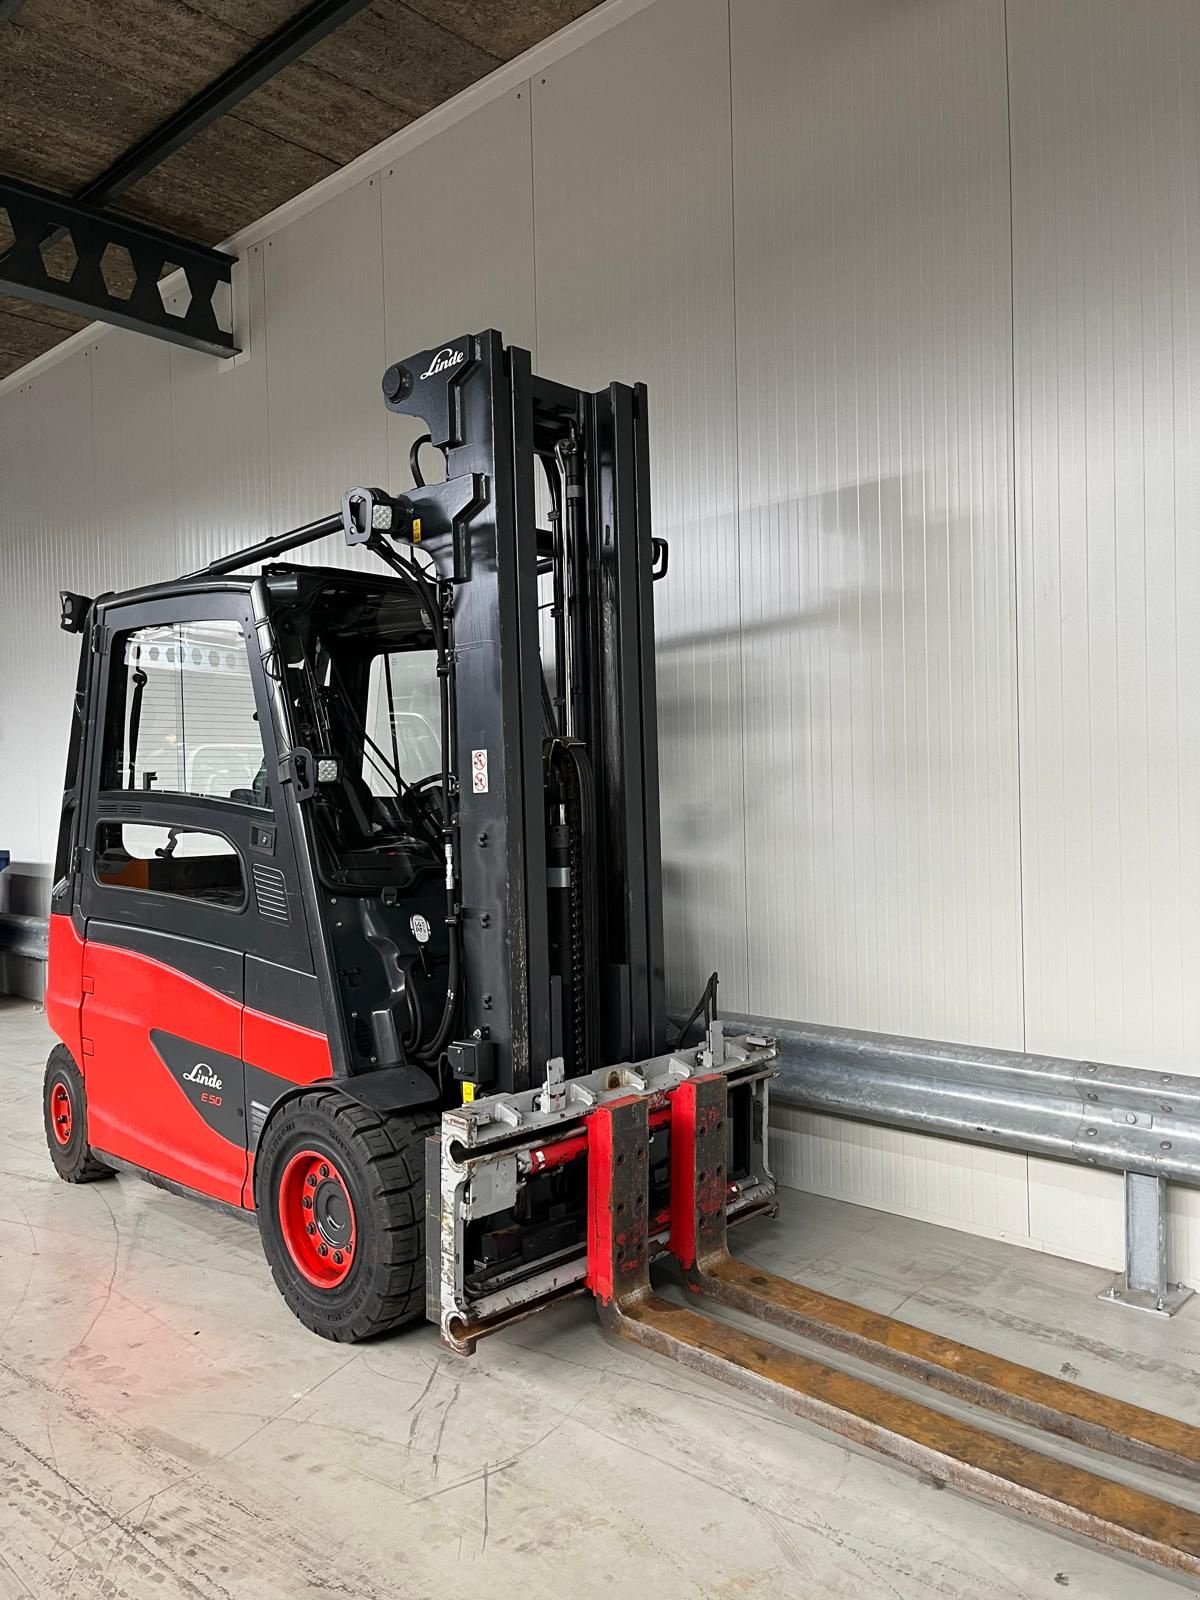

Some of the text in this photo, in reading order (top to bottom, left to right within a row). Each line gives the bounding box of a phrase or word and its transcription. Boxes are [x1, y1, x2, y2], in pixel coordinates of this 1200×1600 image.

[420, 348, 464, 380] Linde
[183, 1063, 222, 1090] Linde
[208, 1095, 222, 1106] 50
